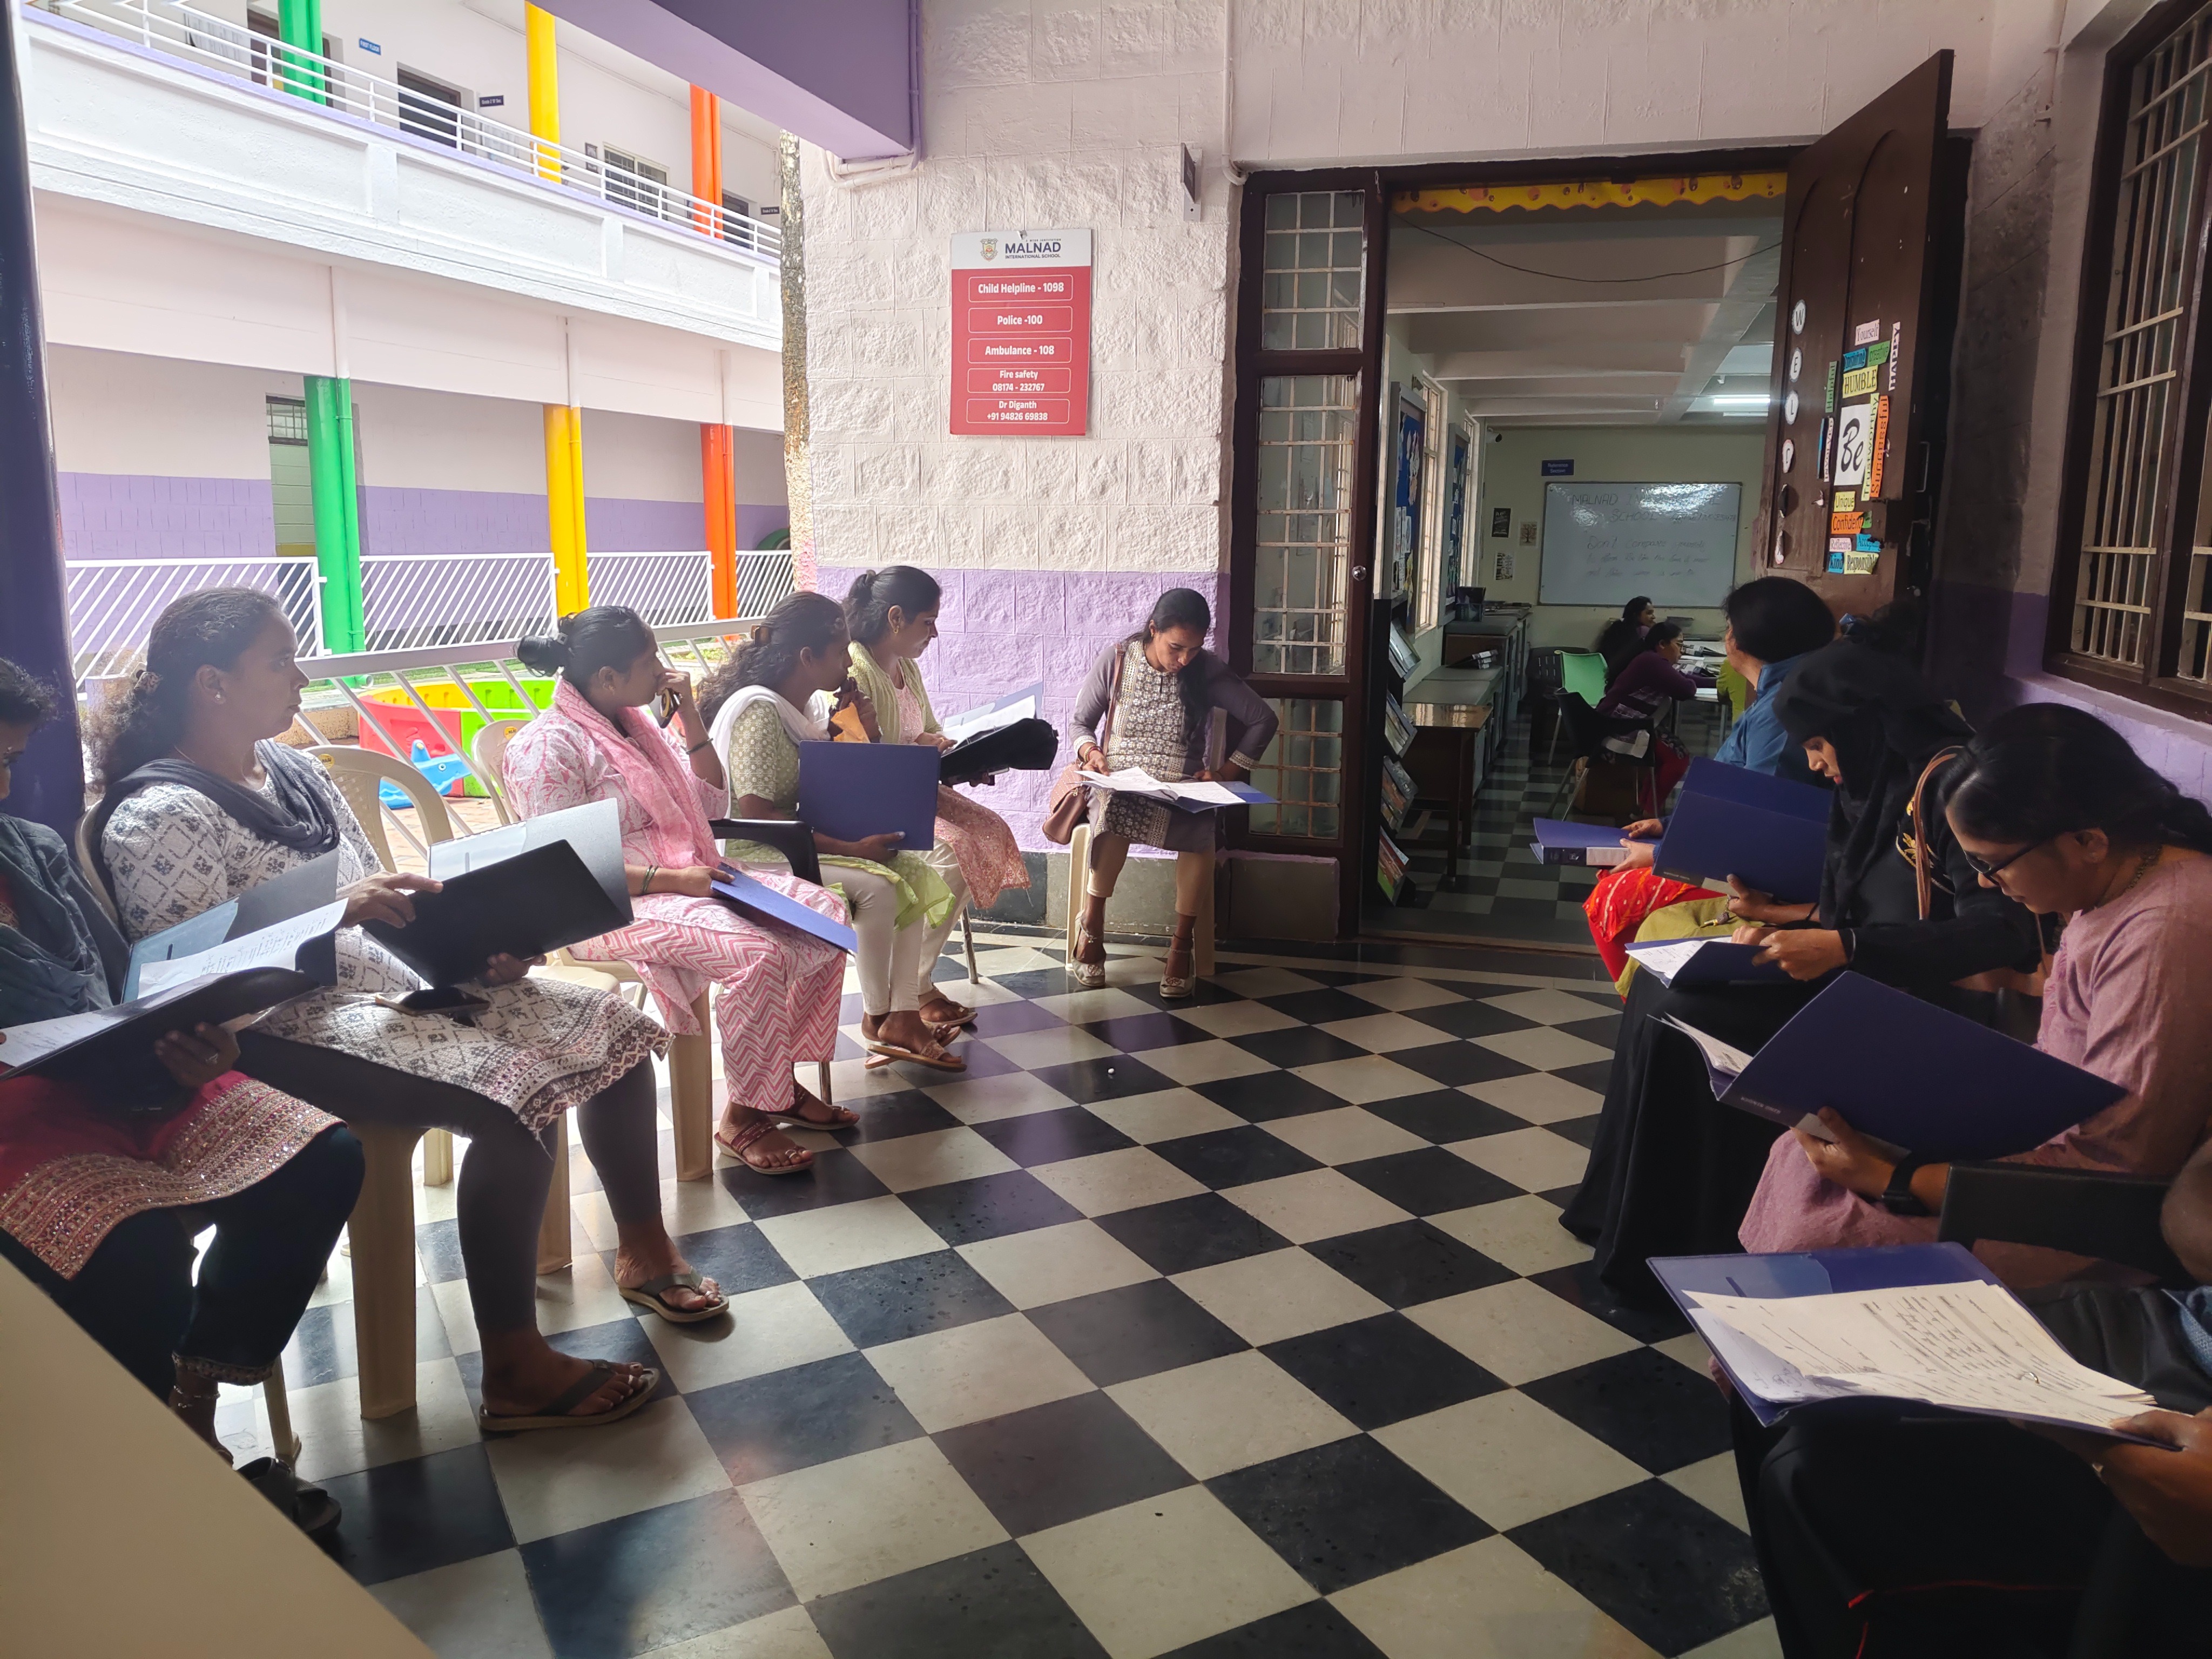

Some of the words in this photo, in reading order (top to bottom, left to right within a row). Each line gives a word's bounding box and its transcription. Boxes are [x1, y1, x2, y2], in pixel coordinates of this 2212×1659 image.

[1005, 242, 1061, 254] MALNAD
[978, 284, 999, 293] Child
[1001, 282, 1036, 295] Helpline
[1043, 282, 1064, 292] 1098
[997, 315, 1022, 325] Police
[1857, 323, 1878, 341] Yourself
[984, 345, 1032, 355] Ambulance
[1038, 345, 1055, 355] 108
[1000, 369, 1014, 378] Fire
[1015, 370, 1038, 380] safety
[992, 383, 1014, 391] 08174
[1020, 383, 1045, 391] 232767
[1844, 369, 1877, 394] HUMBLE
[1008, 400, 1037, 410] Diganth
[1000, 412, 1023, 420] 94826
[1024, 412, 1048, 420] 69838
[1841, 417, 1864, 473] Be
[1864, 397, 1879, 499] Trustworthy
[1871, 398, 1887, 495] Successful
[1572, 494, 1618, 506] MALNAD
[1836, 495, 1854, 510] Unique
[1610, 508, 1657, 523] SCHOOL
[1830, 539, 1851, 550] Reflective
